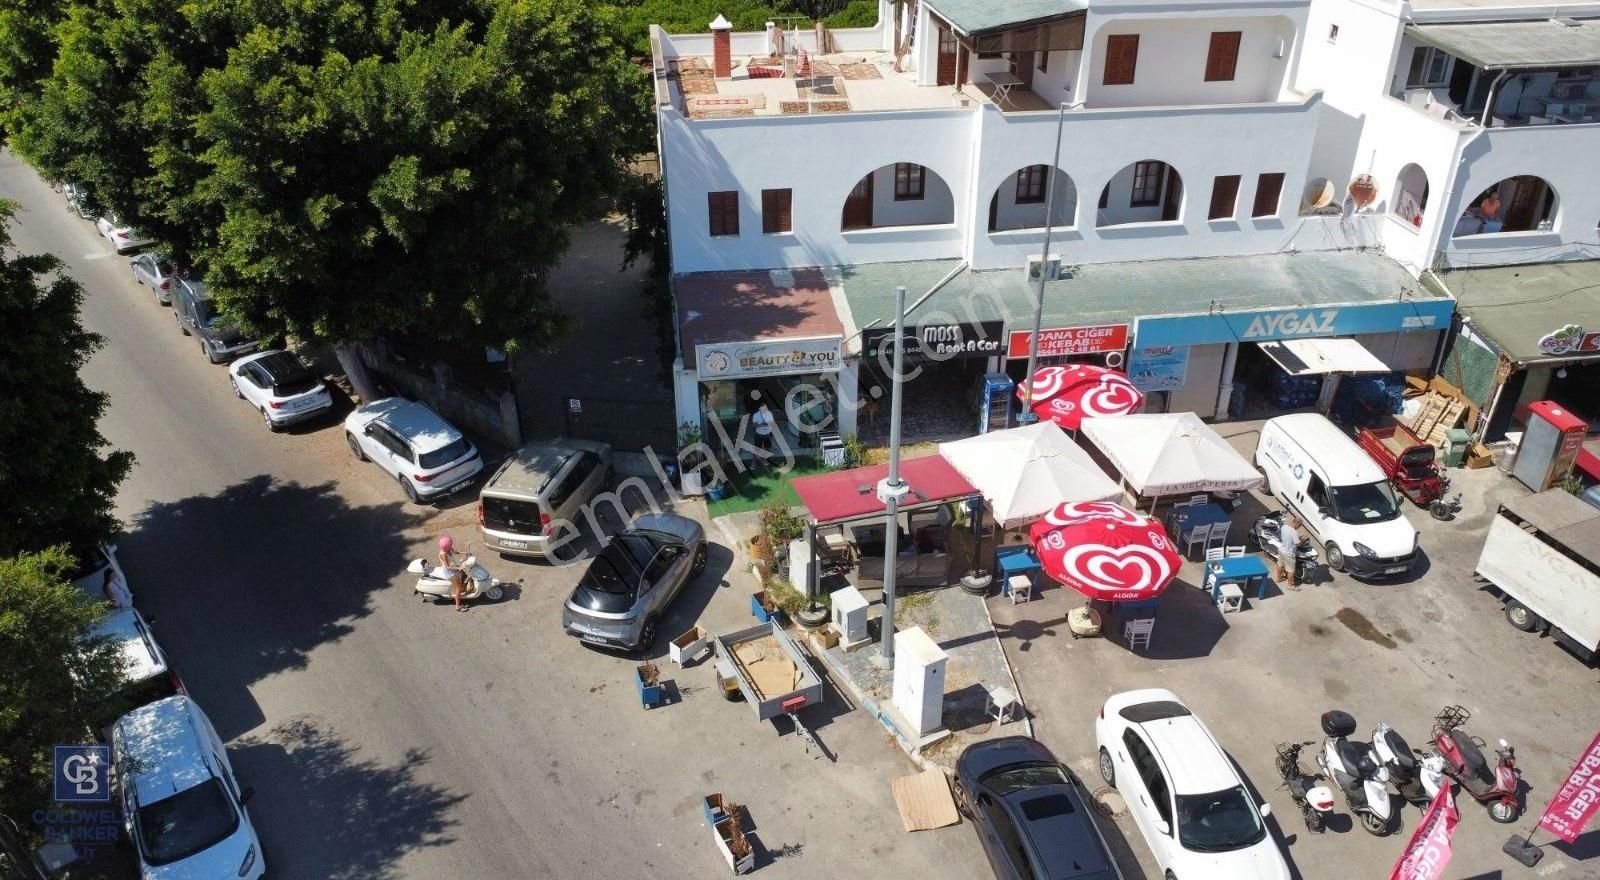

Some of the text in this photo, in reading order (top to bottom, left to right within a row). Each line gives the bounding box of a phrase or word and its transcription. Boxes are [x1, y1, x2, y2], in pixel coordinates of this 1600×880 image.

[1243, 310, 1339, 338] AYGAZ
[923, 324, 961, 343] MOSS
[966, 340, 977, 352] A
[977, 338, 999, 352] Car
[1047, 338, 1090, 350] KEBAB
[739, 353, 791, 368] BEAUTY
[809, 351, 836, 363] YOU
